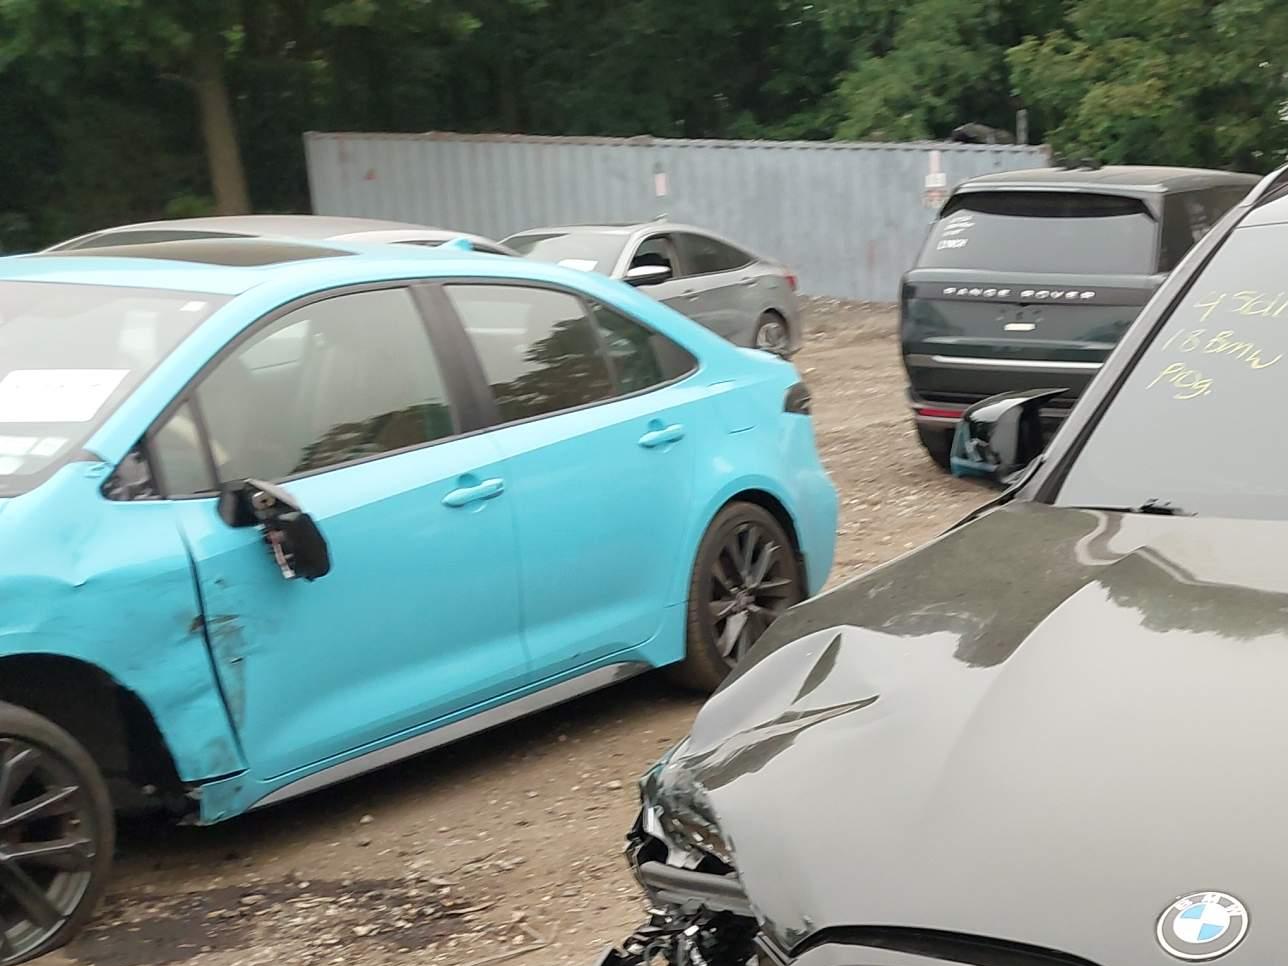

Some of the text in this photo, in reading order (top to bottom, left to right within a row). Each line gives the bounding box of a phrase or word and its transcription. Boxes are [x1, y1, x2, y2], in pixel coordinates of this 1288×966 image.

[943, 287, 1096, 299] RANGE ROVER
[1173, 892, 1243, 917] BMW
